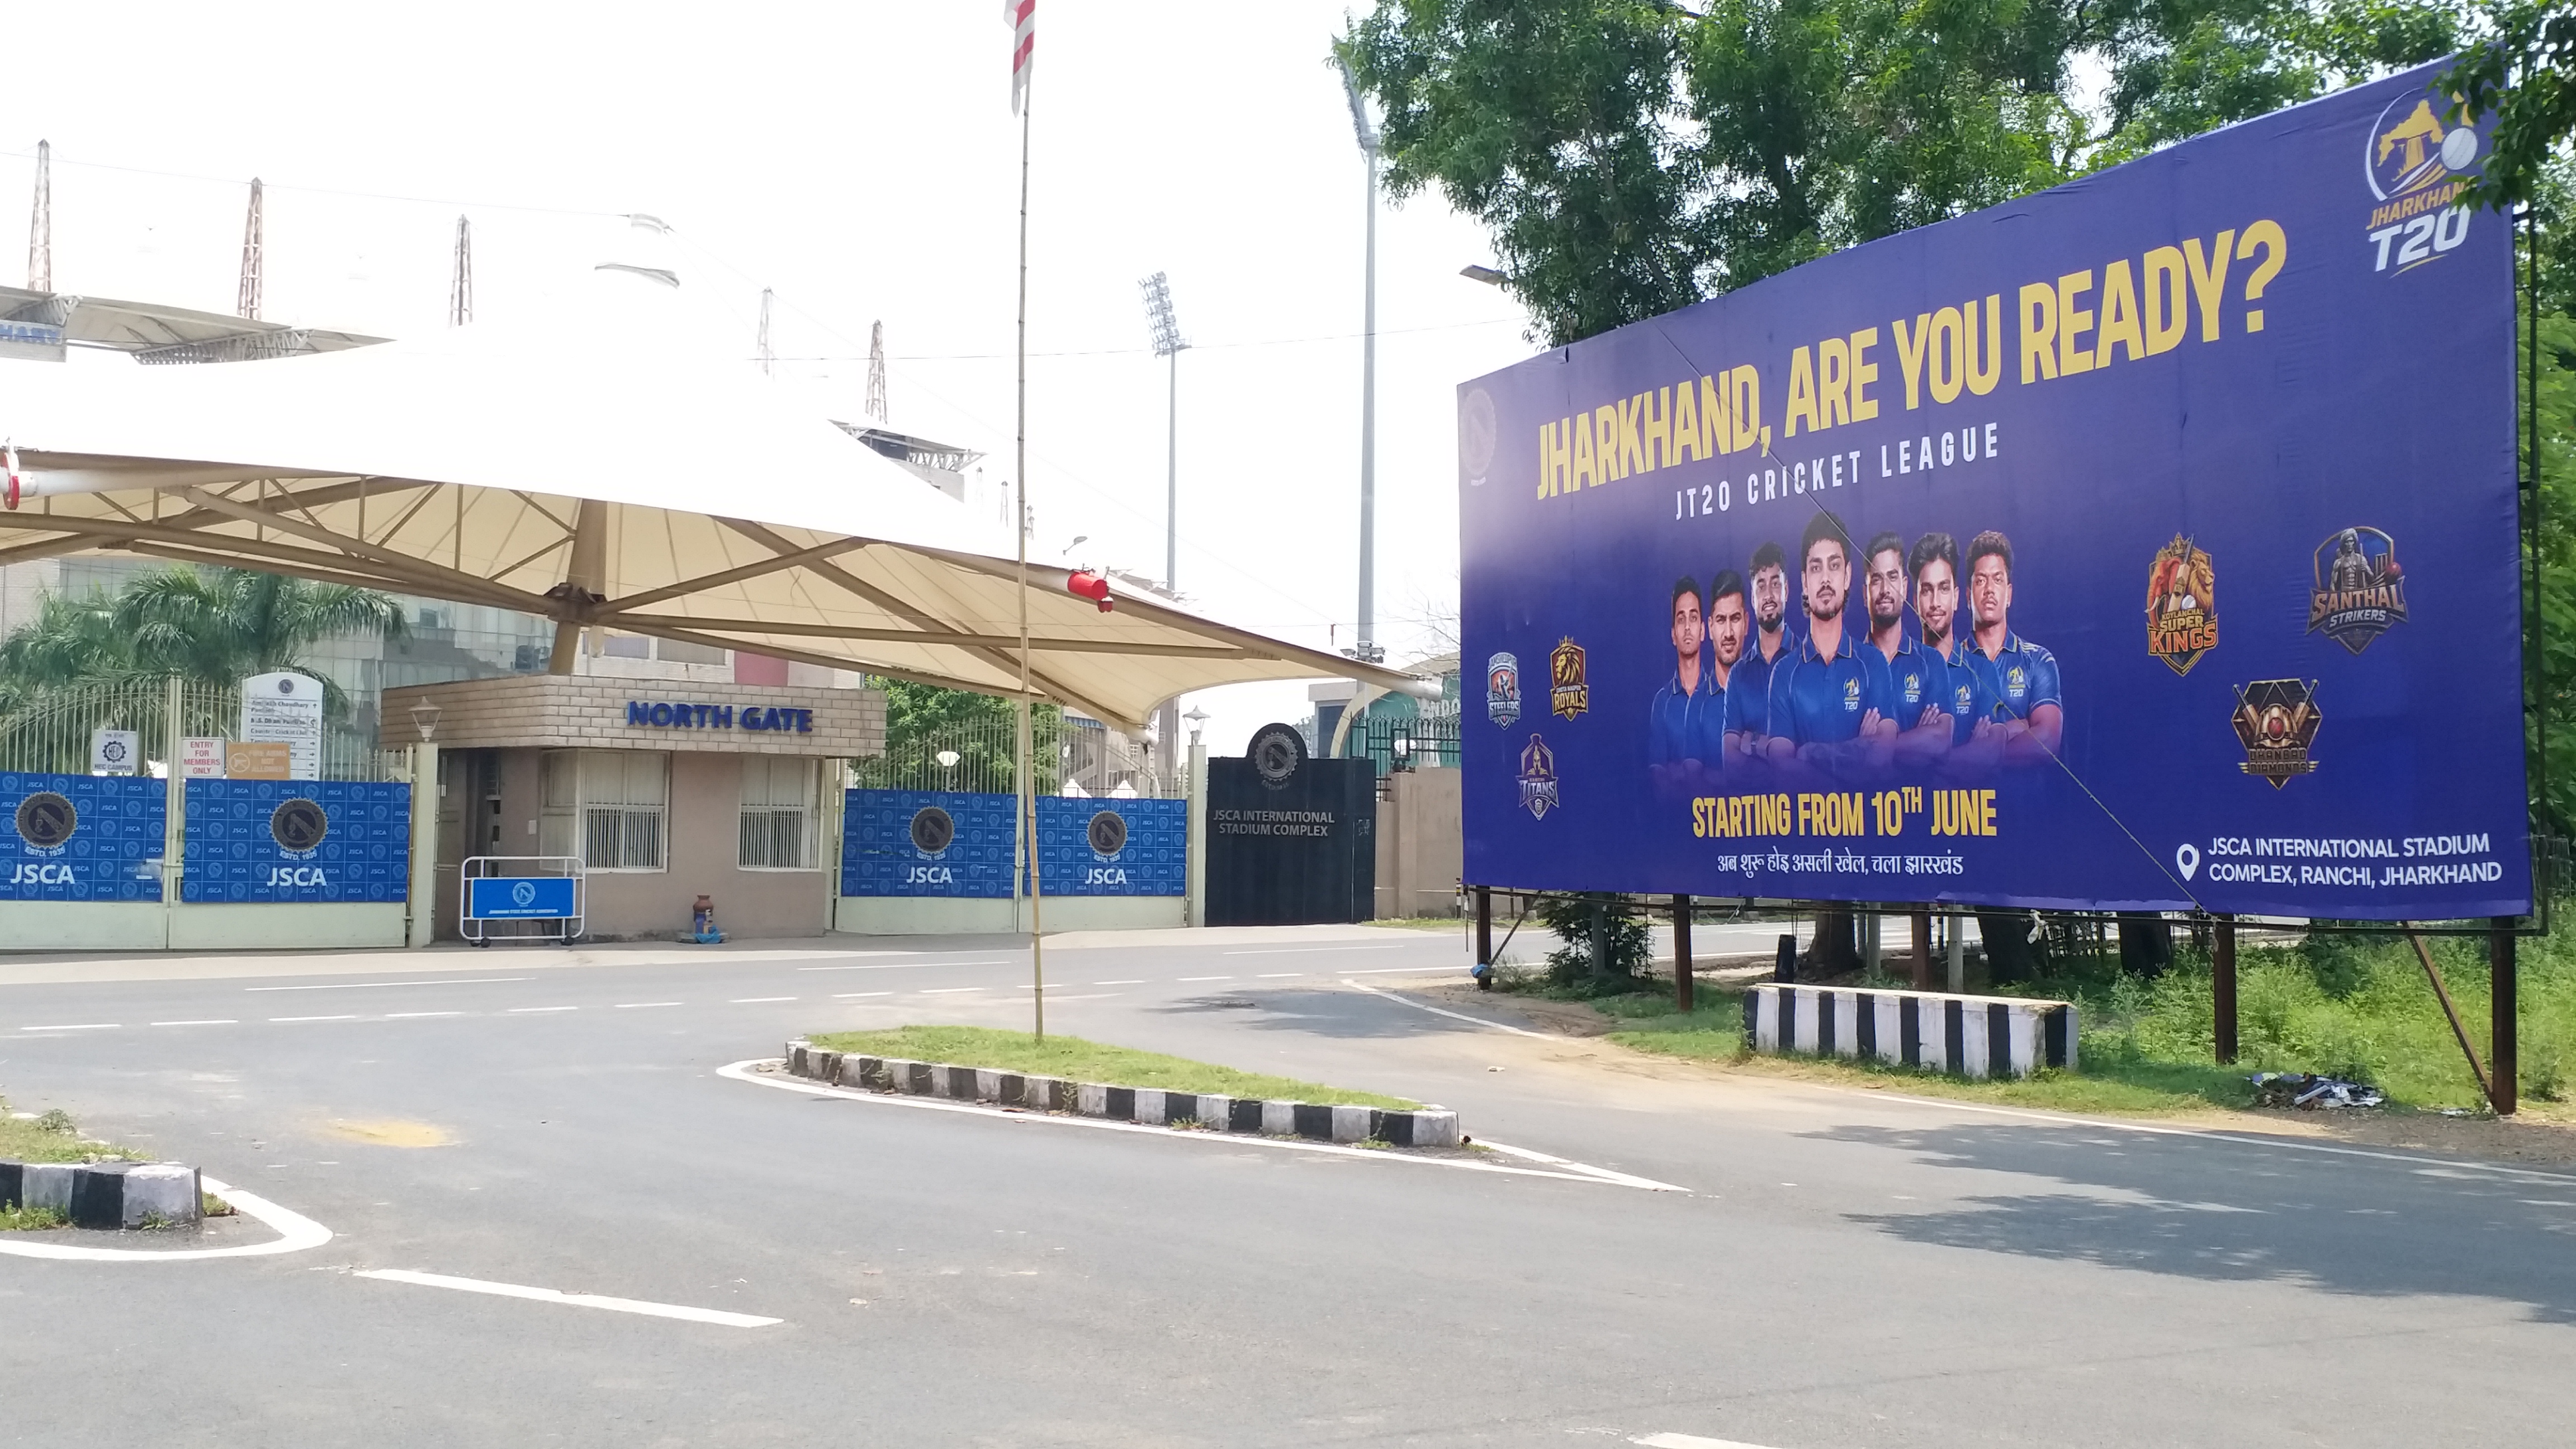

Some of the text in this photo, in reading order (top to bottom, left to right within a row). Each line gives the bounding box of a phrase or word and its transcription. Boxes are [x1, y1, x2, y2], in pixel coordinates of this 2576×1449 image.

[2366, 182, 2466, 231] JHARKHAN
[2369, 203, 2471, 272] T20
[1537, 219, 2287, 500] JHARKHAND, ARE YOU READY?
[1675, 423, 1997, 520] JT20 CRICKET LEAGUE
[2311, 584, 2404, 622] SANTHAL
[2160, 615, 2204, 633] SUPER
[2329, 609, 2386, 628] STRIKERS
[2150, 622, 2216, 653] KINGS
[1554, 690, 1585, 711] ROYALS
[1906, 694, 1919, 703] T20
[2009, 689, 2024, 697] T20
[1844, 701, 1858, 710] T20
[628, 701, 813, 732] NORTH GATE
[2250, 761, 2308, 774] DIAMONDS
[1519, 780, 1555, 800] TITANS
[1213, 810, 1335, 823] JSCA INTERNATIONAL
[1692, 793, 1791, 837] STARTING
[1798, 792, 1864, 836] FROM
[1931, 789, 1997, 836] JUNE
[1219, 823, 1328, 837] STADIUM COMPLEX
[2208, 833, 2490, 858] JSCA INTERNATIONAL STADIUM
[1717, 845, 1963, 878] अब शुरू होइ असली खेल, चला झारखंड
[10, 864, 75, 884] JSCA
[267, 867, 327, 886] JSCA
[906, 866, 953, 884] JSCA
[1085, 869, 1128, 884] JSCA
[2209, 861, 2502, 889] COMPLEX, RANCHI, JHARKHAND
